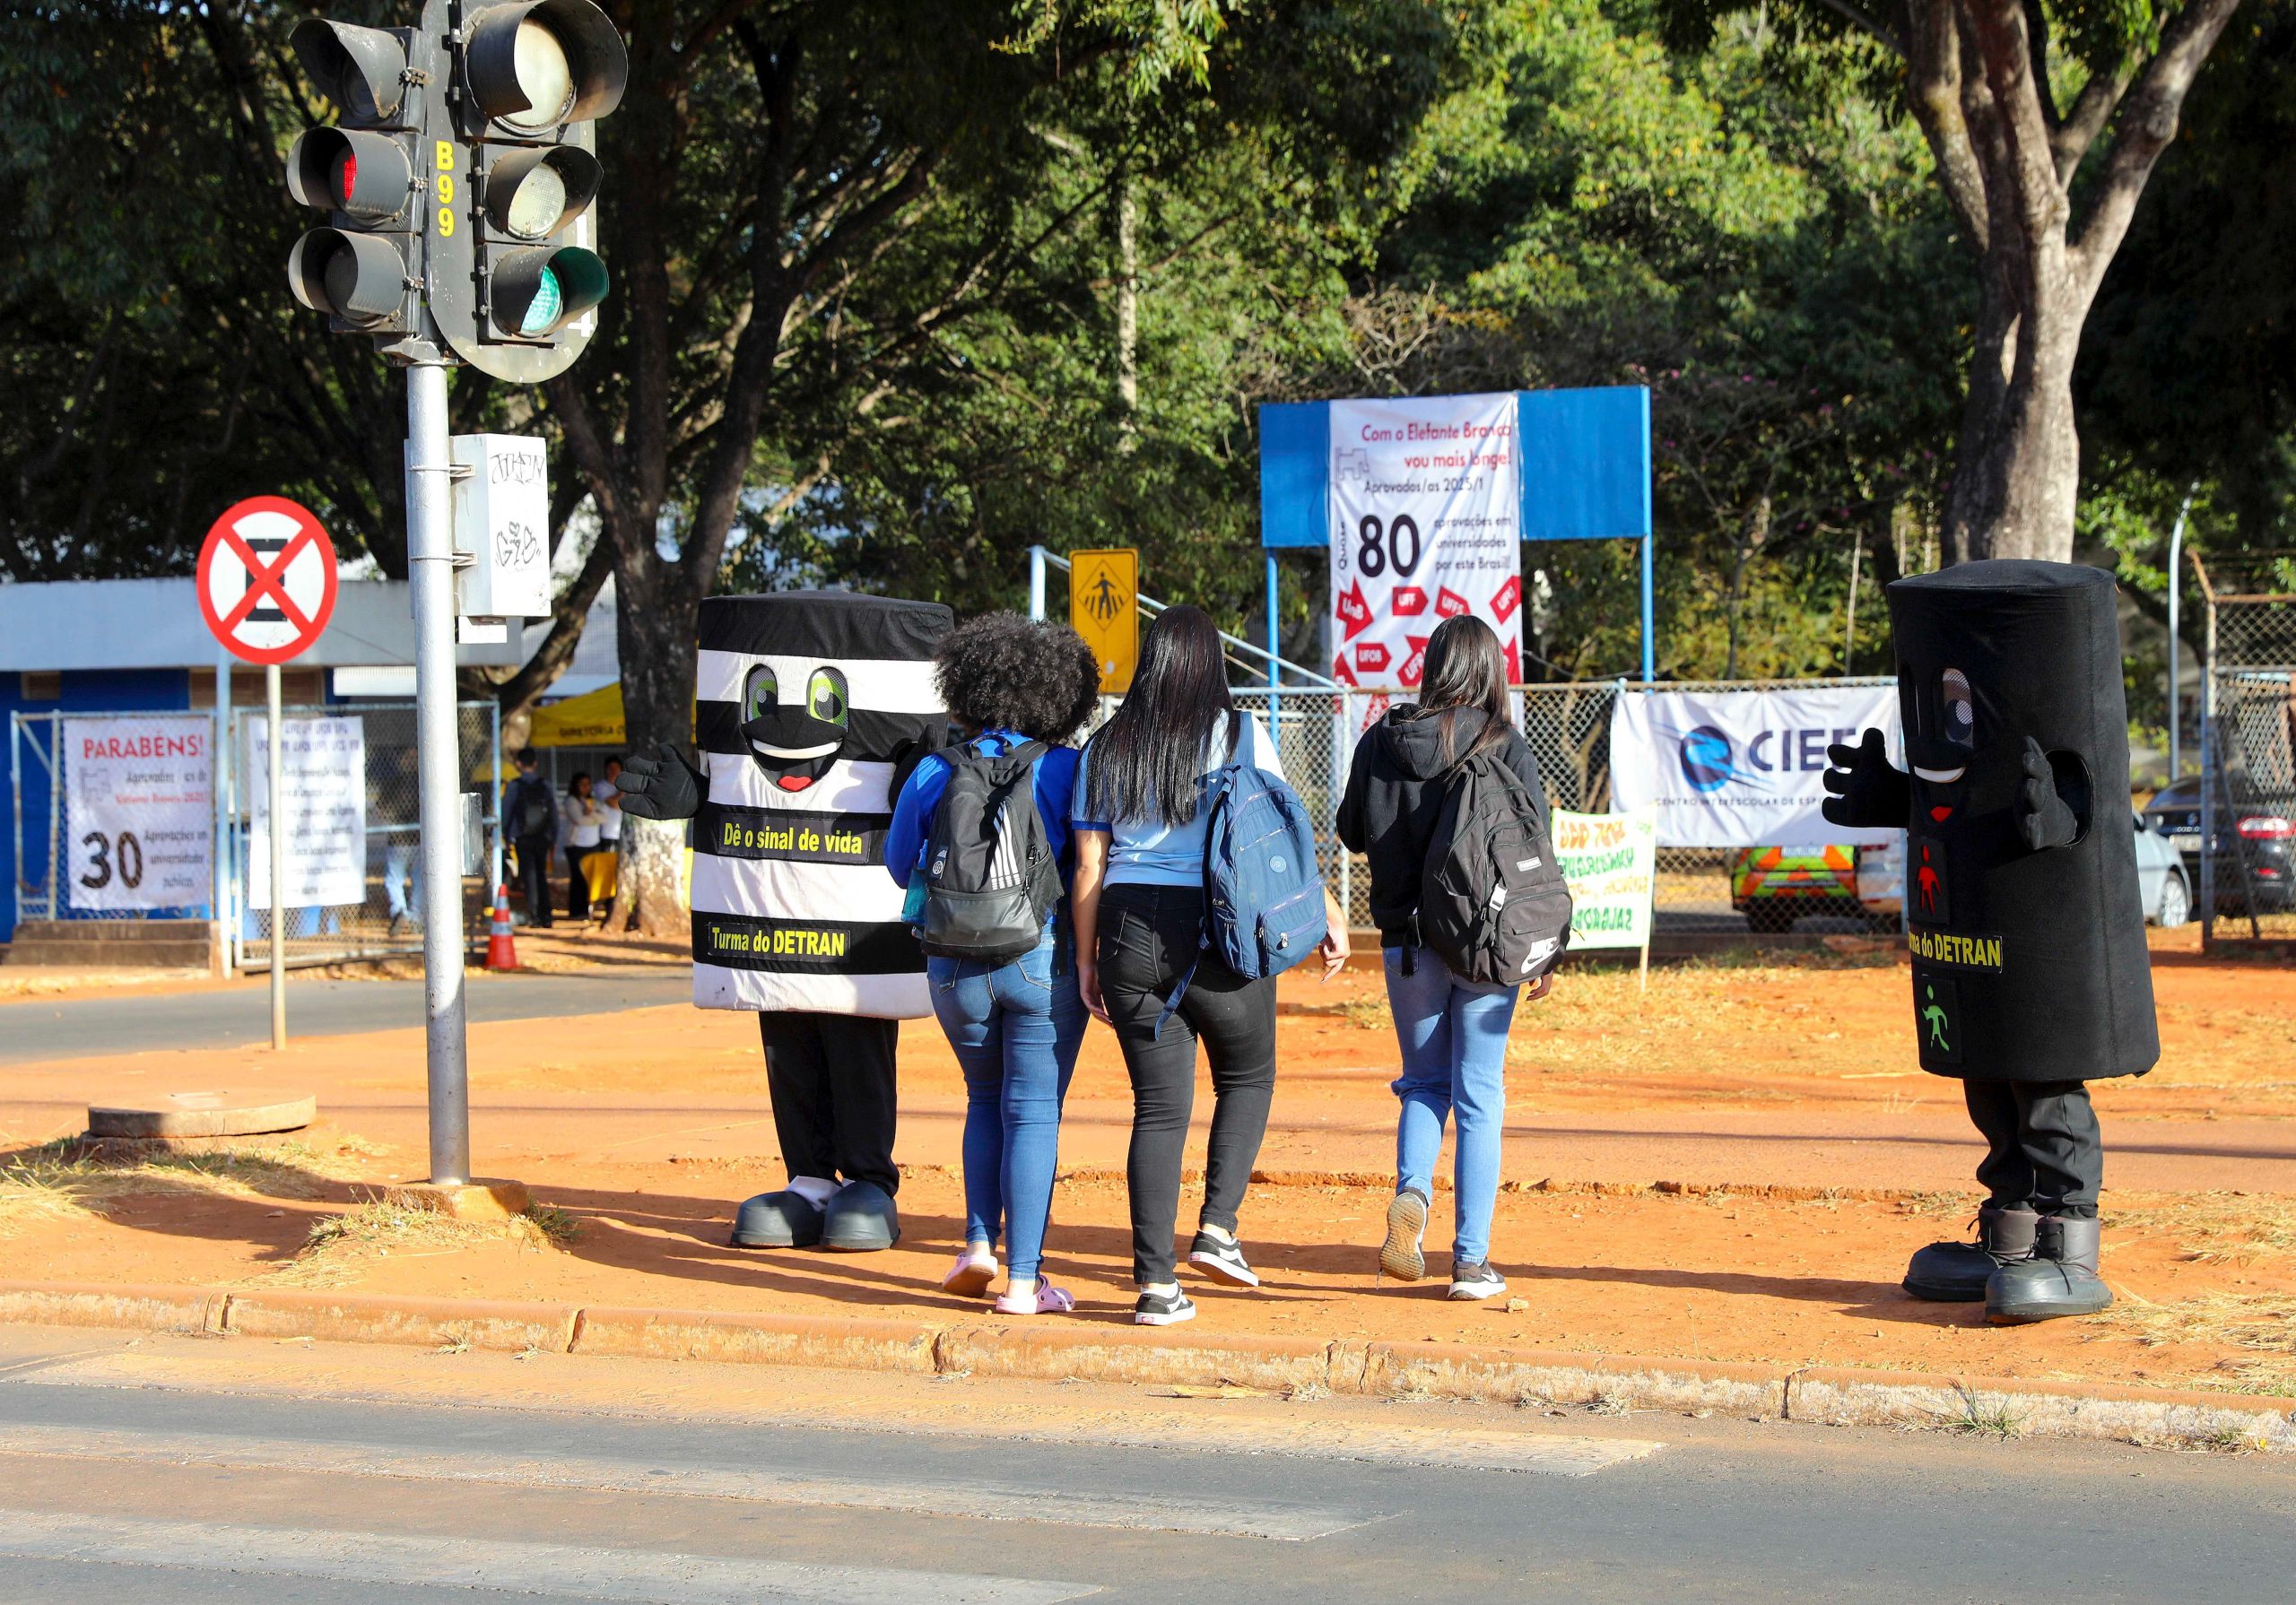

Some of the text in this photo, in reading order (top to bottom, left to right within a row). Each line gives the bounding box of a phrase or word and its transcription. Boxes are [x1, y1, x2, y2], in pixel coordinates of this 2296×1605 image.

[436, 141, 454, 237] B99
[1362, 421, 1511, 441] Com o Elefante Branco
[1405, 455, 1429, 468] vou
[1434, 451, 1465, 467] mais
[1358, 514, 1420, 577] 80
[1437, 534, 1506, 549] universidades
[83, 729, 204, 759] PARABÉNS!
[724, 822, 862, 855] Dê o sinal de vida
[80, 831, 143, 889] 30
[712, 926, 845, 957] Turma do DETRAN
[1921, 932, 1934, 959] do
[1935, 933, 2001, 967] DETRAN
